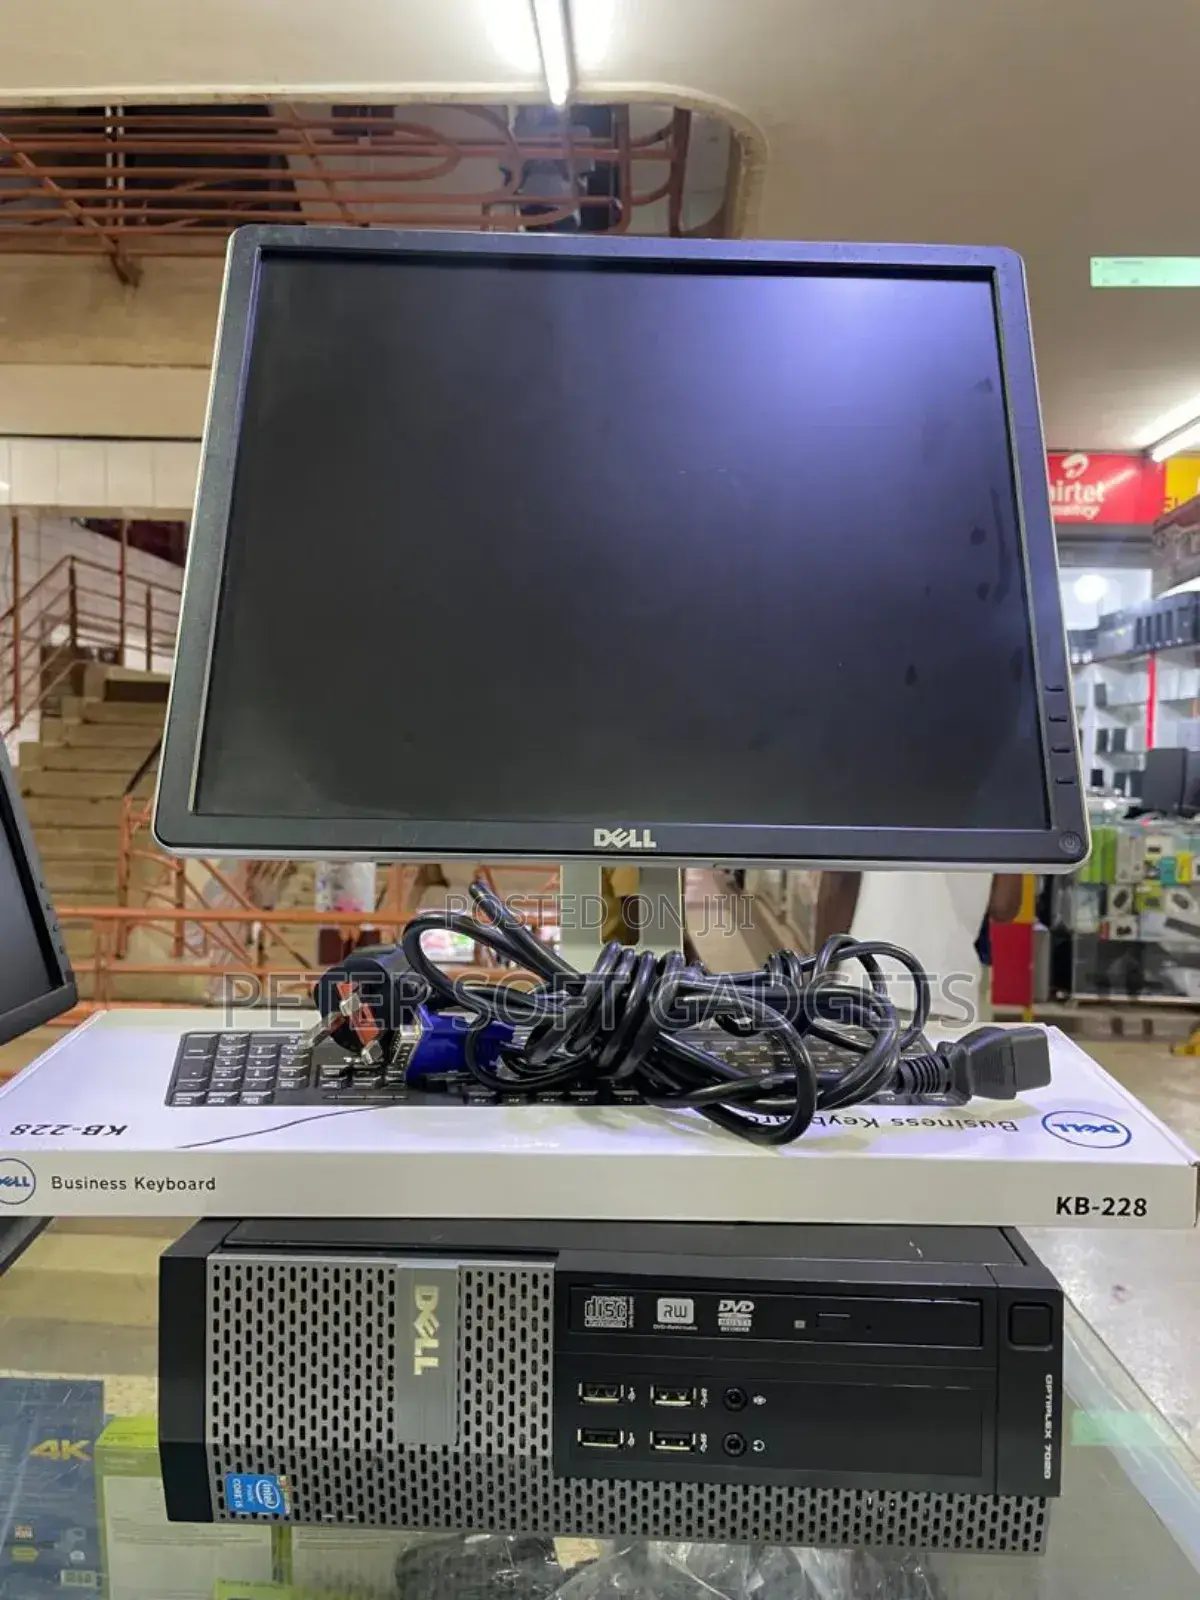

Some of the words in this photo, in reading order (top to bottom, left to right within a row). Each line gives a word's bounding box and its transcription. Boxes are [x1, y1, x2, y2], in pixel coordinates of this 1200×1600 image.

[593, 827, 657, 848] DELL
[10, 1123, 128, 1136] KB-228
[891, 1116, 1019, 1132] Business
[1052, 1122, 1121, 1136] DELL
[0, 1176, 31, 1188] ELL
[51, 1175, 127, 1190] Business
[134, 1176, 216, 1193] Keyboard
[1055, 1195, 1148, 1218] KB-228
[663, 1304, 688, 1318] RW
[718, 1300, 755, 1313] DVD
[413, 1285, 439, 1376] DELL
[30, 1439, 93, 1462] 4K
